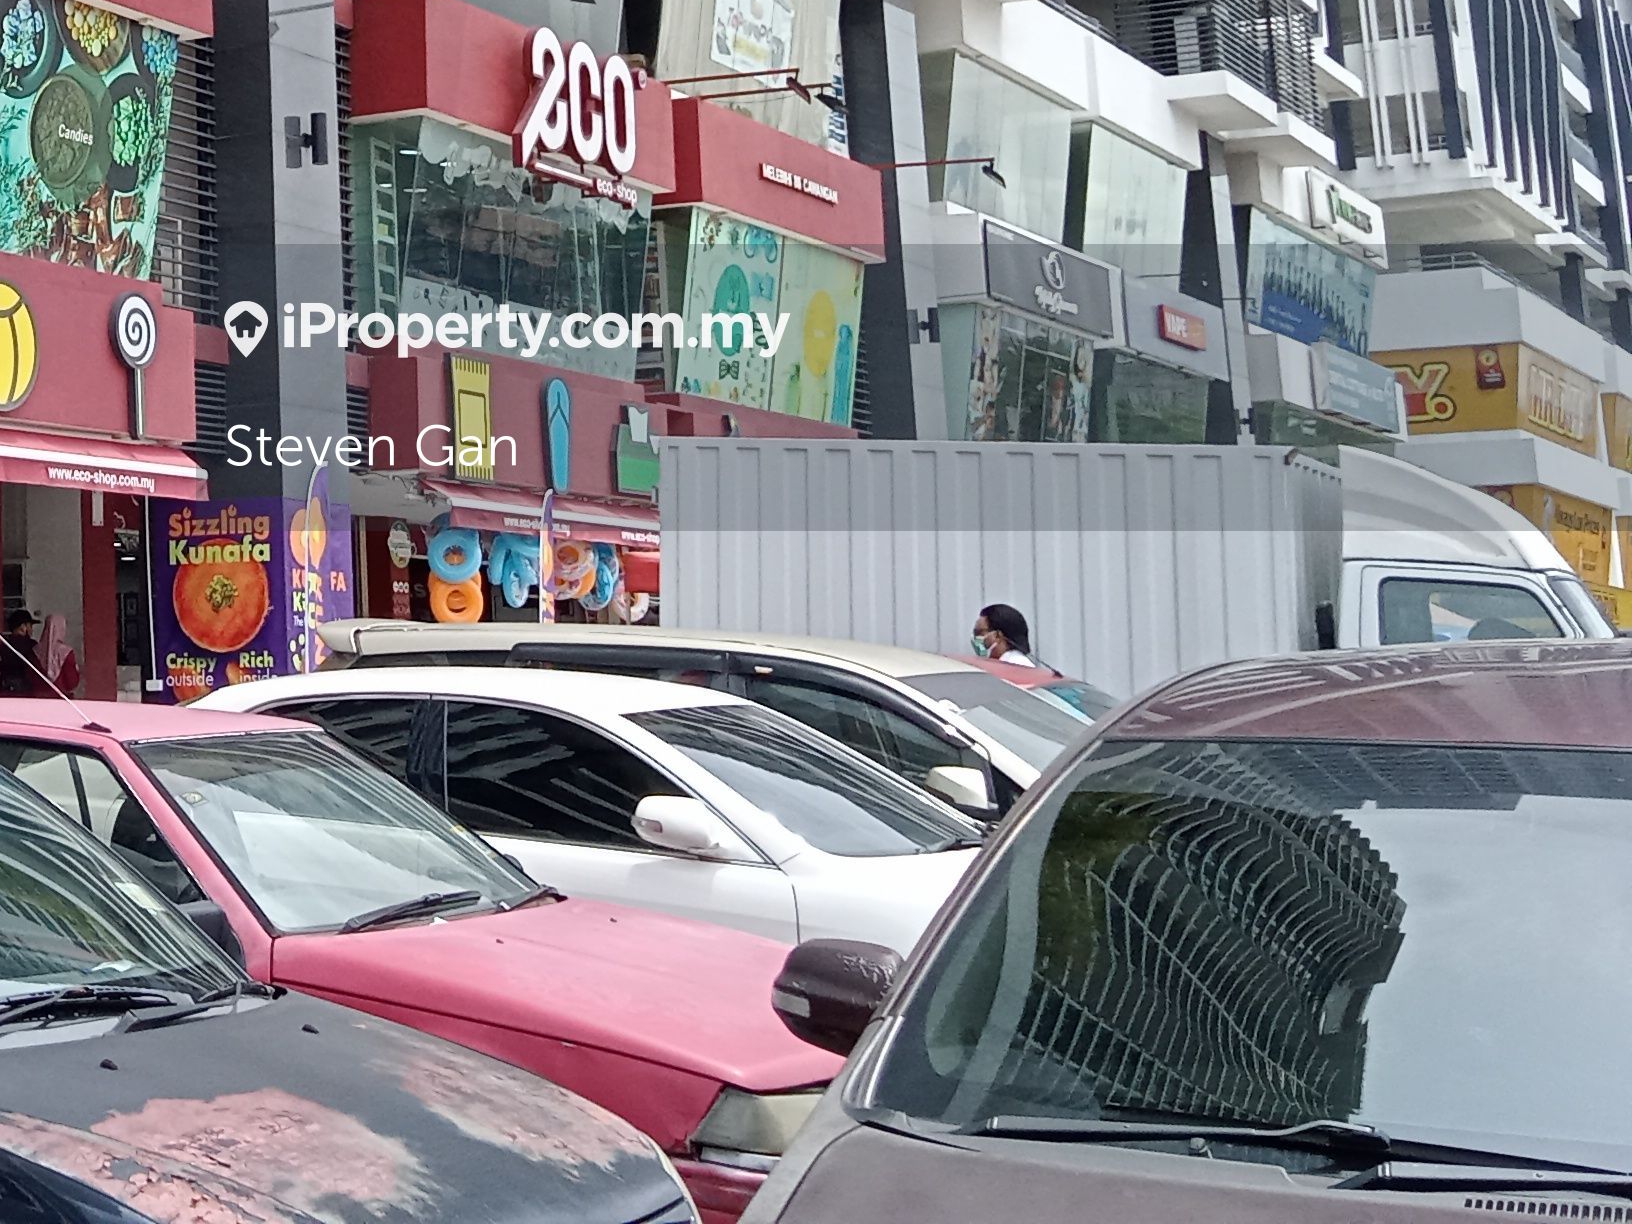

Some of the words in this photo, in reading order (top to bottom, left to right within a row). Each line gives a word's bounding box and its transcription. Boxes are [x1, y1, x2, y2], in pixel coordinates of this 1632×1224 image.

[58, 123, 94, 146] Candies
[596, 178, 638, 208] eco-shop
[47, 465, 156, 494] www.eco-shop.com.my
[169, 504, 271, 541] Sizzling
[169, 535, 271, 565] Kunafa
[166, 652, 217, 672] Crispy
[239, 651, 274, 668] Rich
[166, 671, 215, 687] outside
